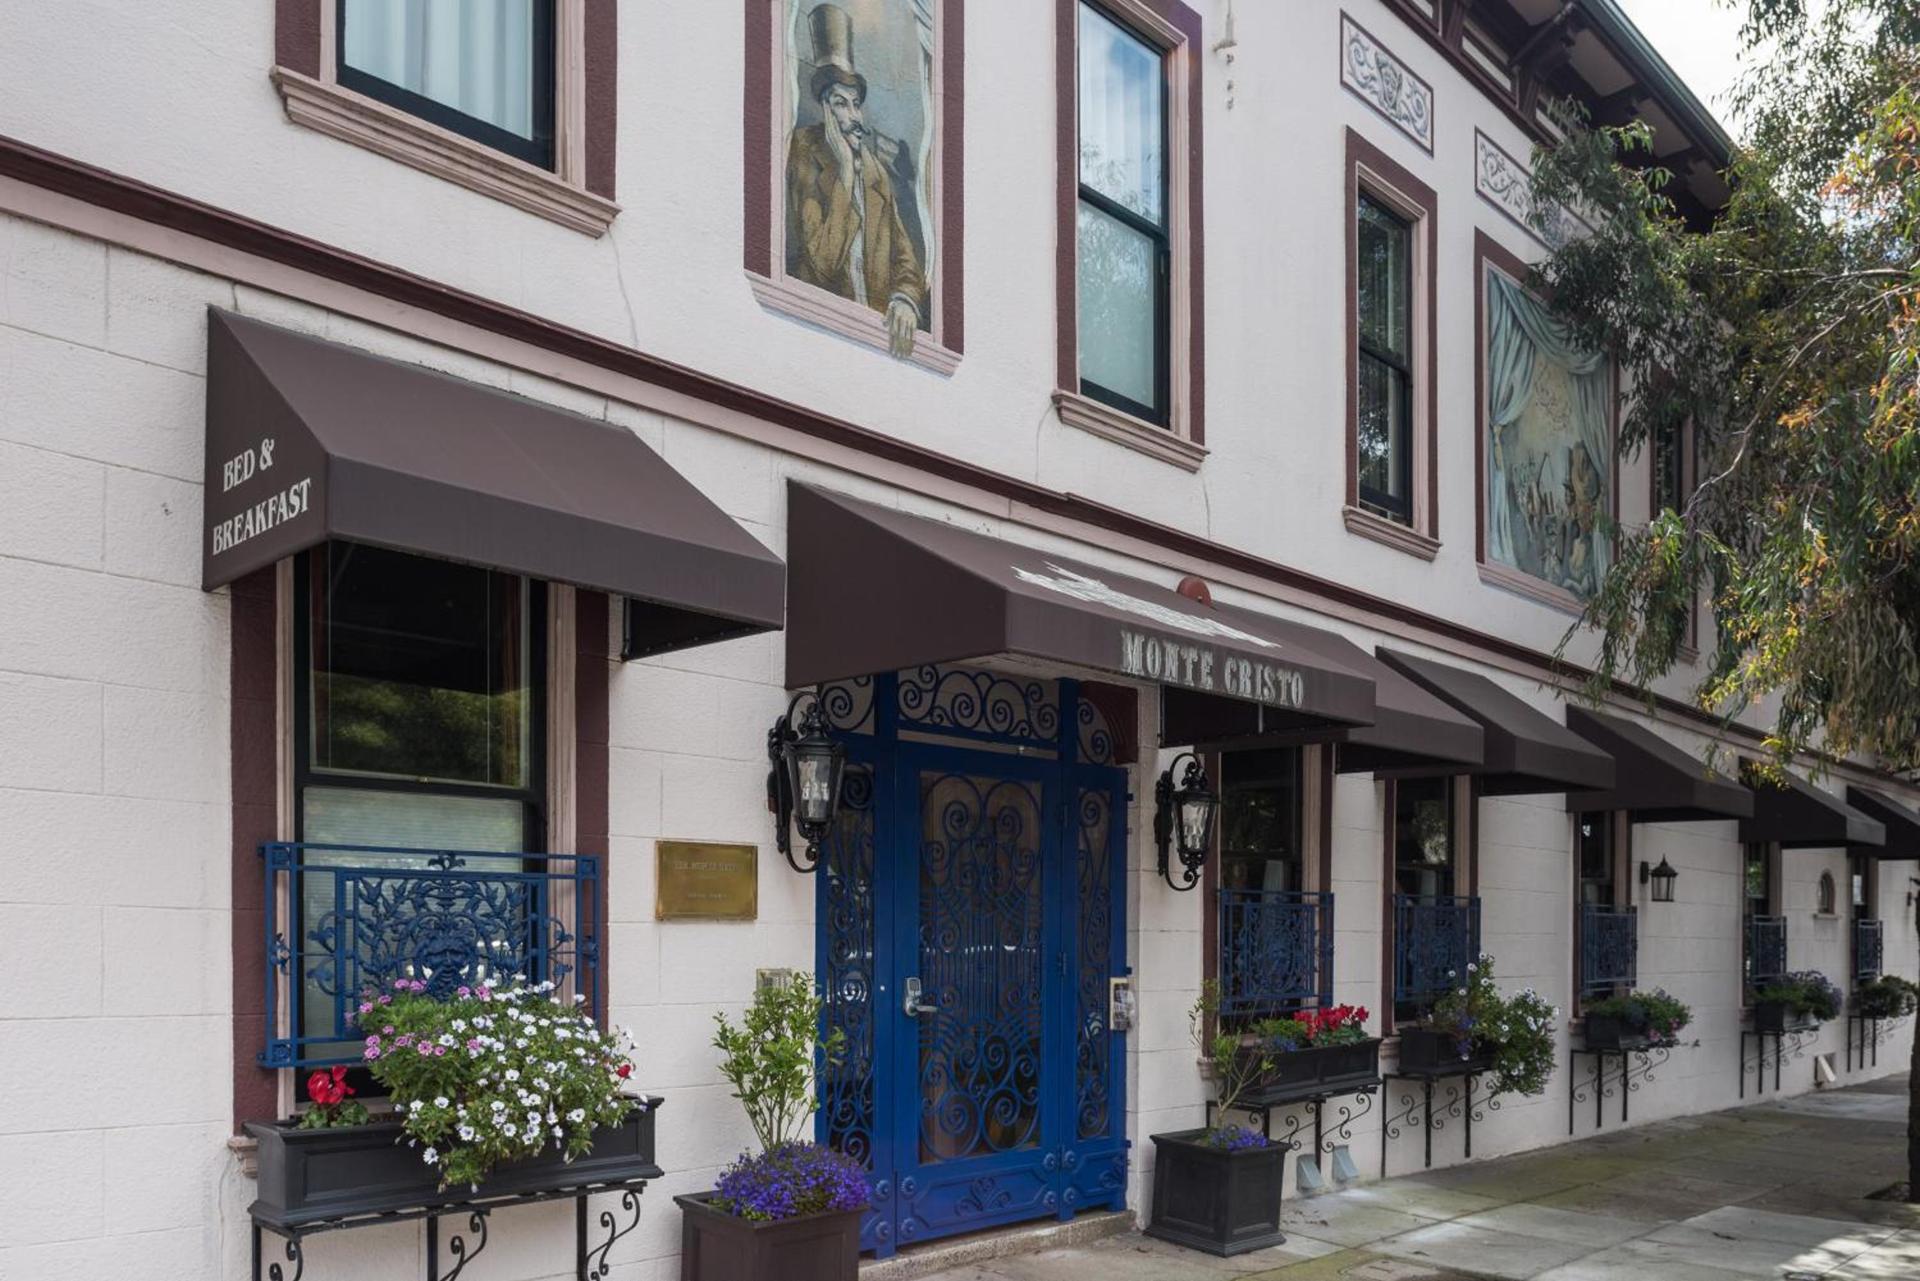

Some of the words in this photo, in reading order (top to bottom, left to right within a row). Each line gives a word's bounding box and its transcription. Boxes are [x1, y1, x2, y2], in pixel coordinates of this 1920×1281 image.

[223, 448, 256, 492] BED
[260, 438, 275, 471] &
[212, 477, 311, 556] BREAKFAST
[1120, 630, 1214, 690] MONTE
[1224, 656, 1304, 708] CRISTO
